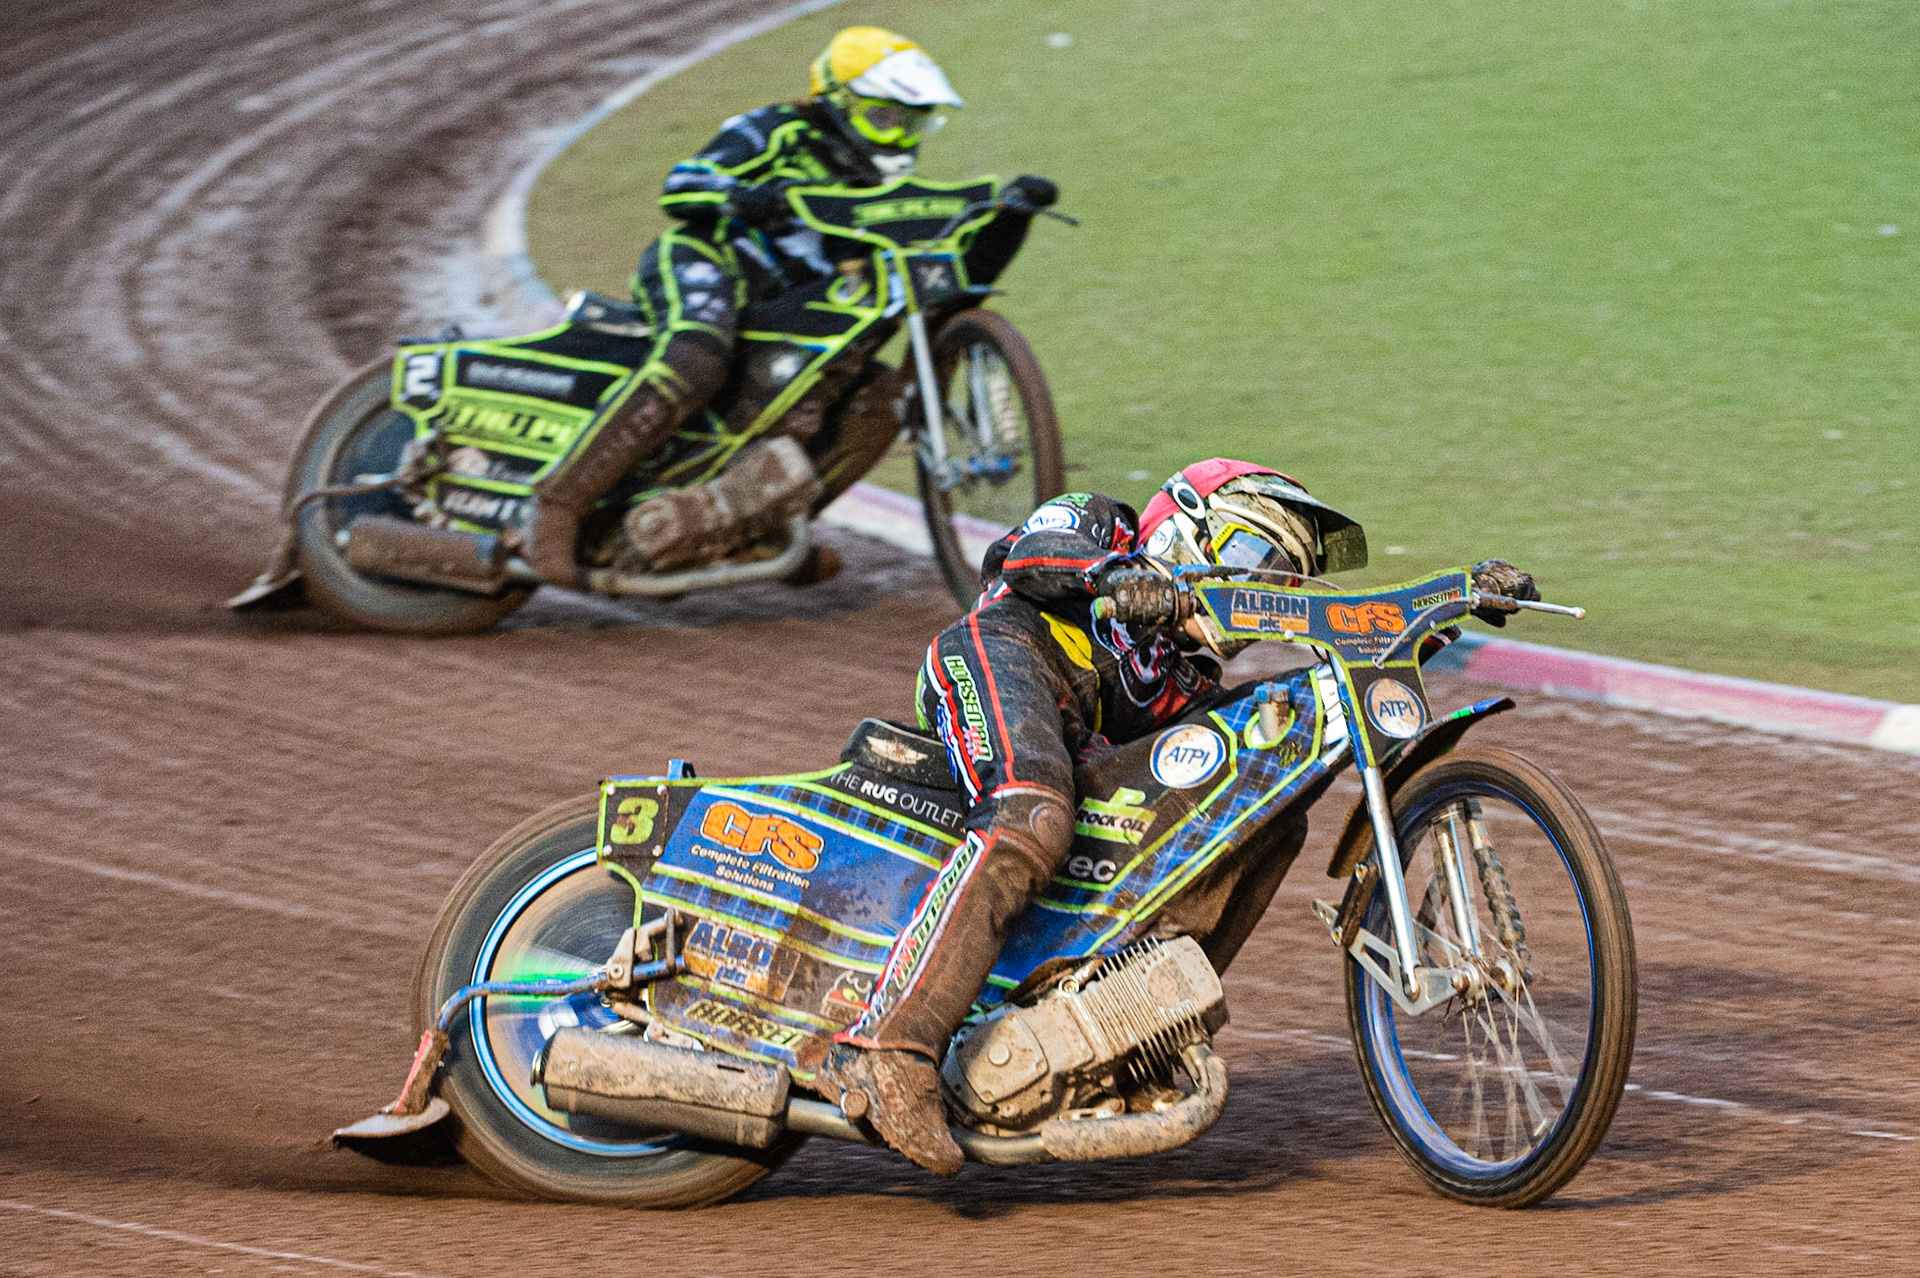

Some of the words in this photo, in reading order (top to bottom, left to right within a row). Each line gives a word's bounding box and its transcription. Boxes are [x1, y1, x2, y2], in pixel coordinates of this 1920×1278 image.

[405, 355, 437, 395] 2
[1234, 590, 1308, 616] ALBON
[1326, 603, 1406, 634] CFS
[1334, 637, 1372, 646] Complete
[1379, 700, 1415, 717] ATPI
[1164, 745, 1211, 768] ATPI
[830, 772, 861, 790] THE
[861, 780, 899, 804] RUG
[900, 792, 962, 828] OUTLET
[610, 797, 659, 845] 3
[701, 801, 823, 872] CFS
[1120, 817, 1146, 832] OIL
[690, 844, 750, 869] Complete
[752, 861, 811, 889] Filtration
[715, 865, 775, 892] Solutions
[689, 921, 788, 973] ALBO
